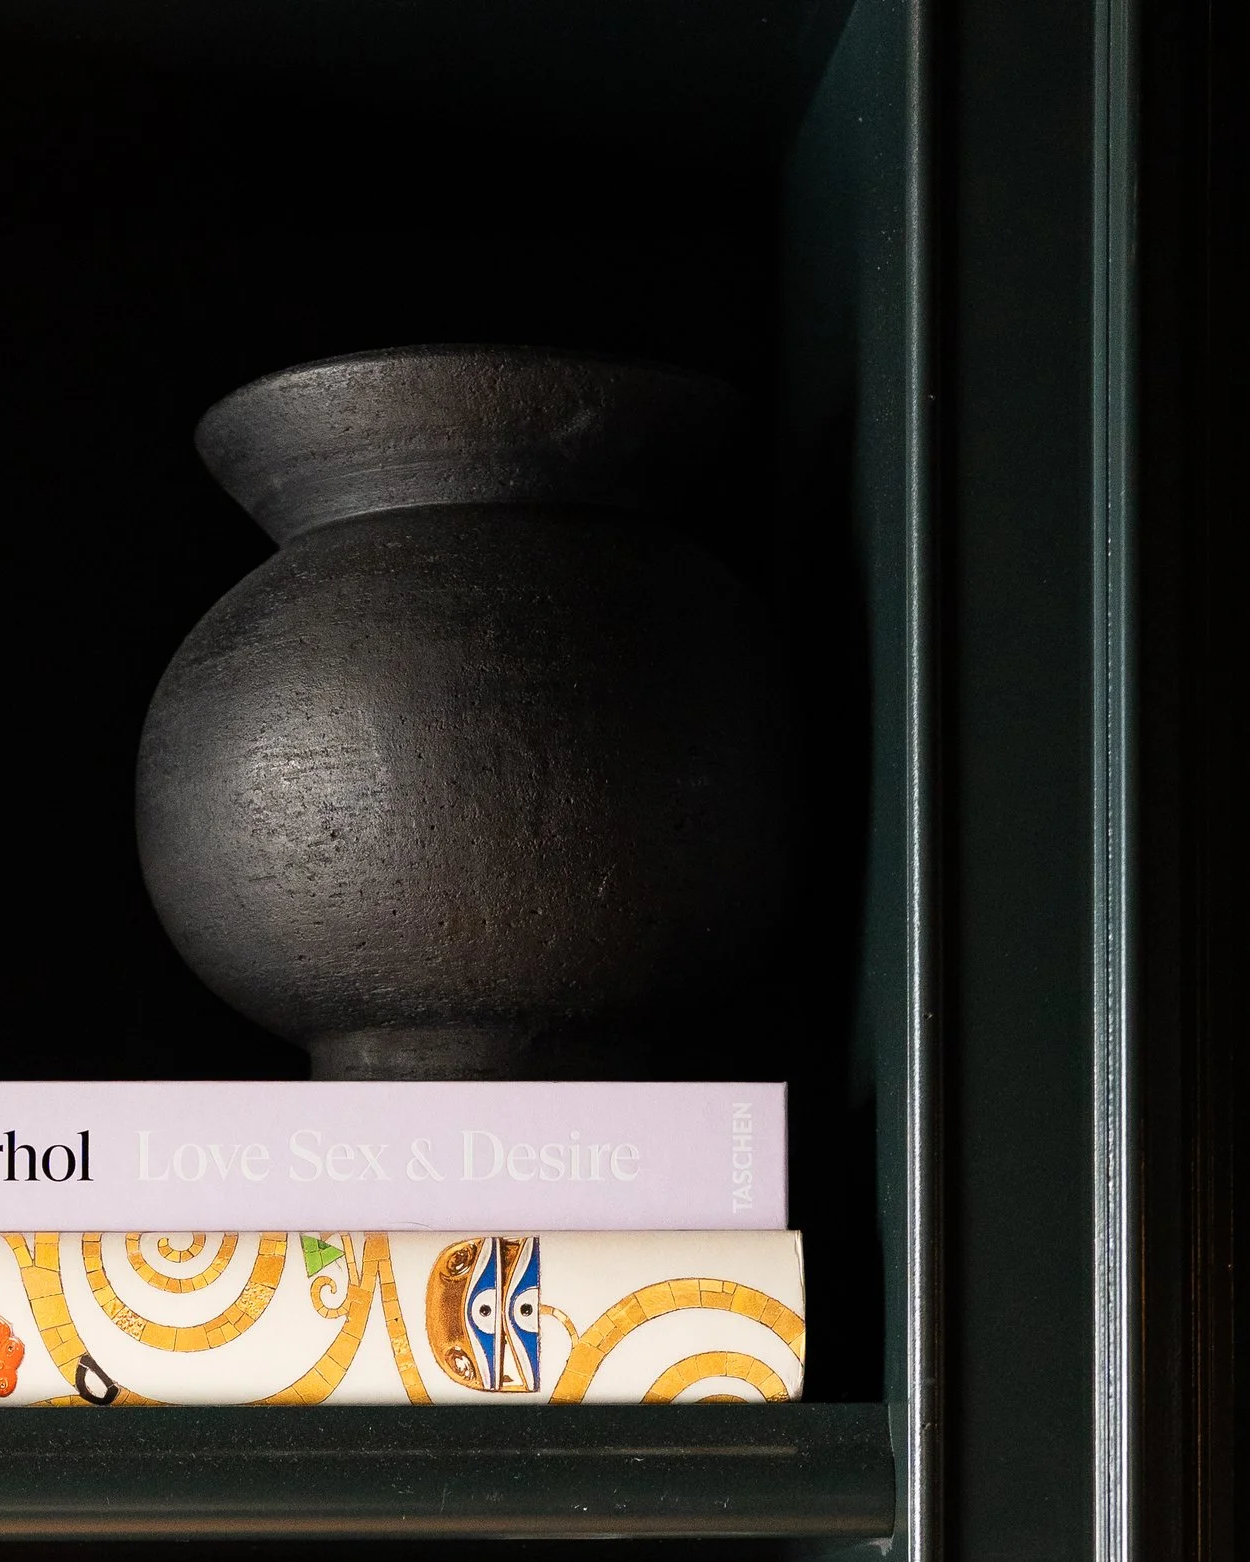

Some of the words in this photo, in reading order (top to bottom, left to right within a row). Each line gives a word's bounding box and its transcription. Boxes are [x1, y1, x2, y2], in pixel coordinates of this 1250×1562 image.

[134, 1129, 272, 1182] Love
[288, 1128, 390, 1182] Sex
[406, 1138, 446, 1182] &
[459, 1128, 641, 1182] Desire
[732, 1102, 752, 1214] TASCHEN
